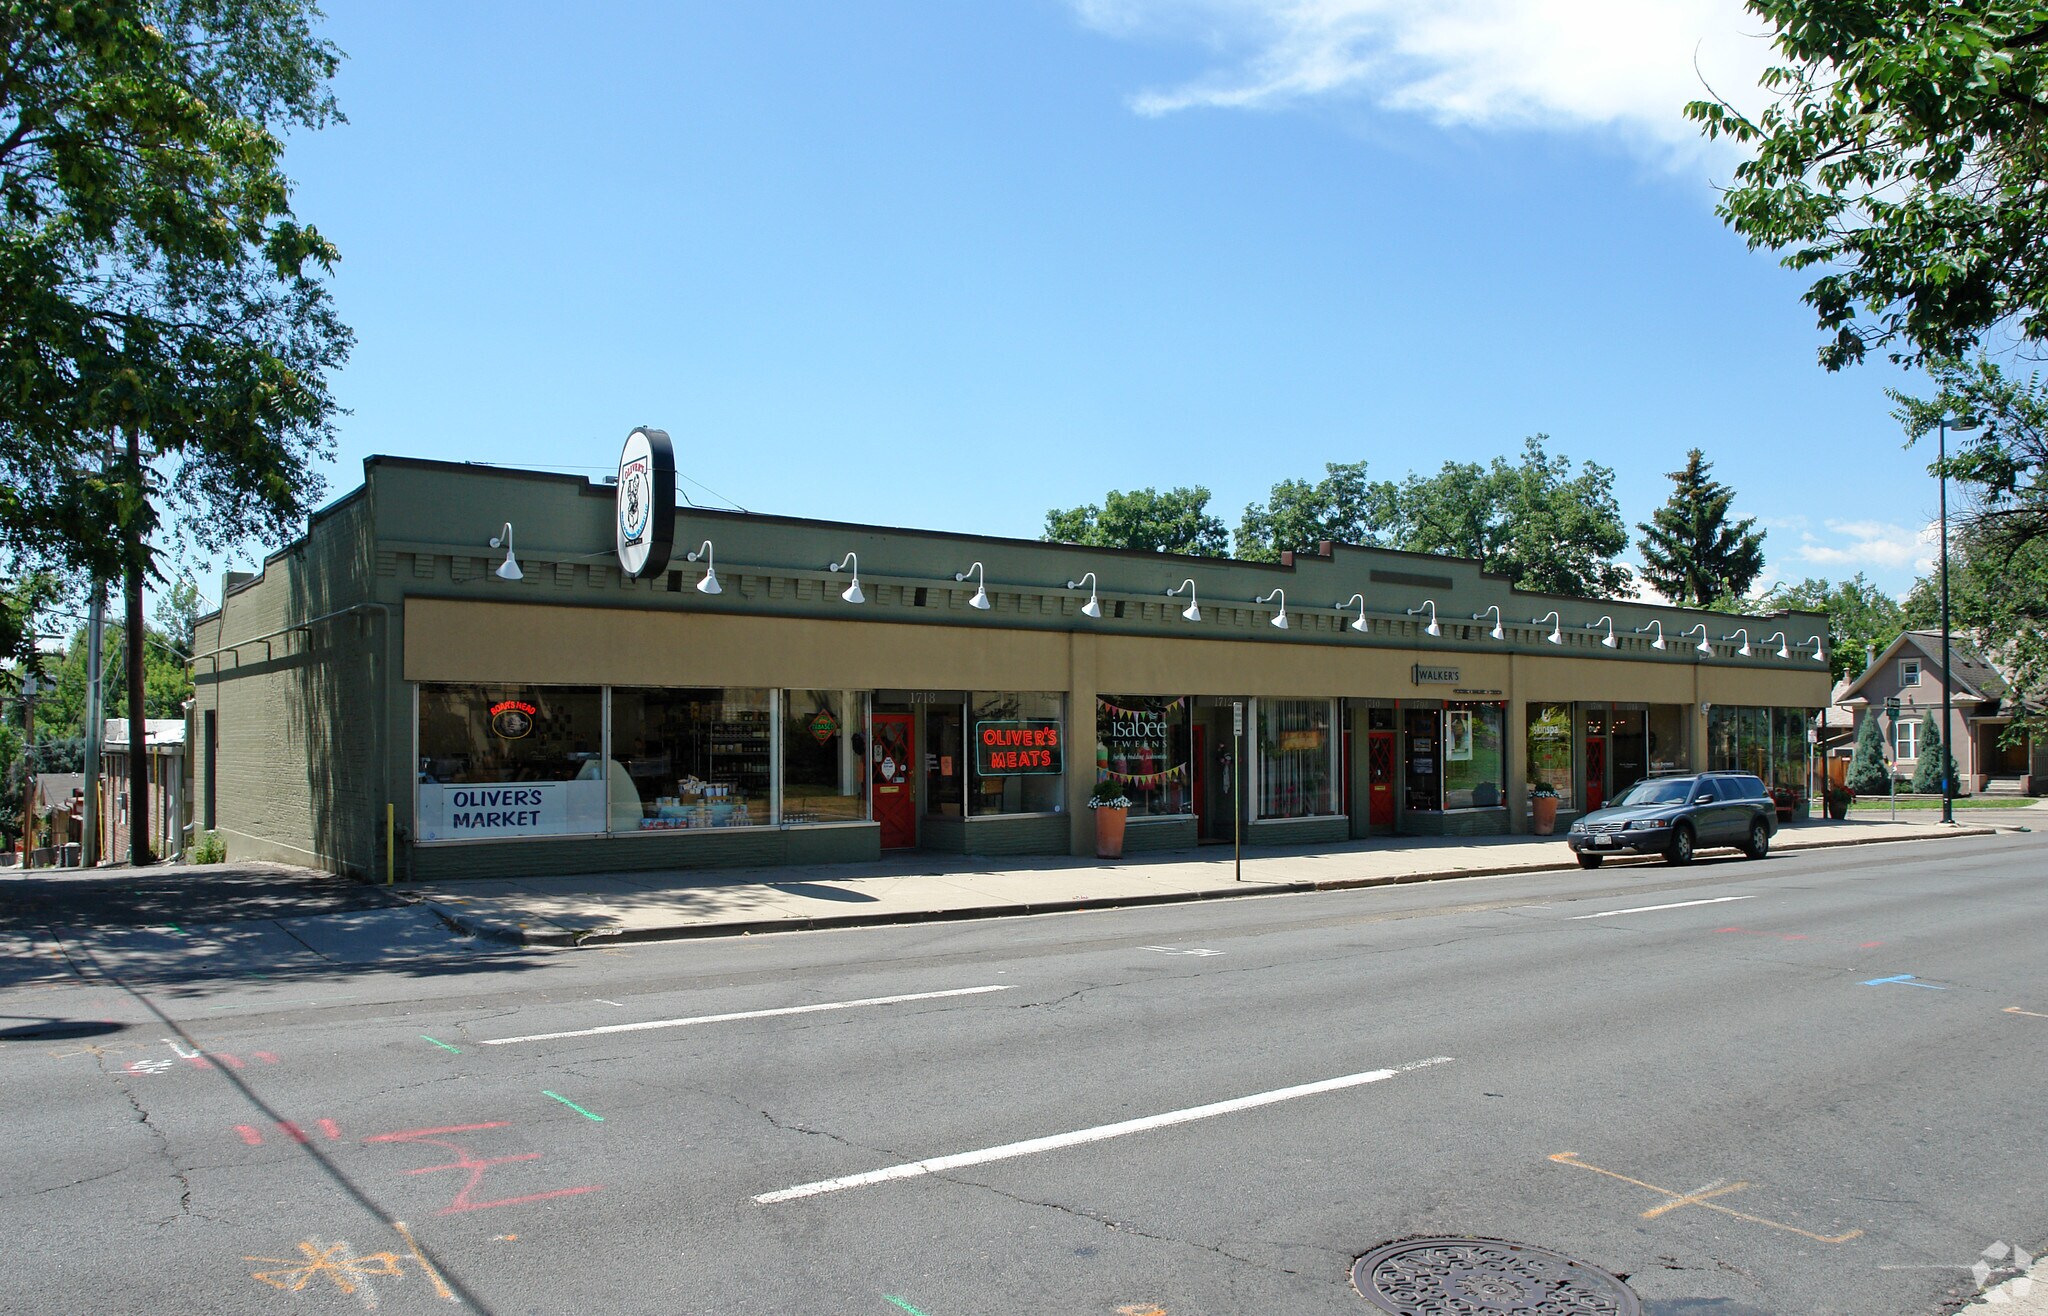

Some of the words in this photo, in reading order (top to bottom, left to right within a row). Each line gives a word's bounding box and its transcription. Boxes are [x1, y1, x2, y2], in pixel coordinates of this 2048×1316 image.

[625, 462, 645, 480] OLIVER'S
[1419, 670, 1459, 681] WALKER'S
[910, 692, 936, 704] 1718
[1214, 696, 1233, 707] 1712
[490, 700, 515, 716] BOAR'S
[516, 701, 536, 715] HEAD
[983, 726, 1057, 746] OLIVER'S
[1112, 740, 1168, 748] TWEENS
[991, 750, 1051, 769] MEATS
[453, 788, 542, 808] OLIVER'S
[453, 810, 541, 829] MARKET
